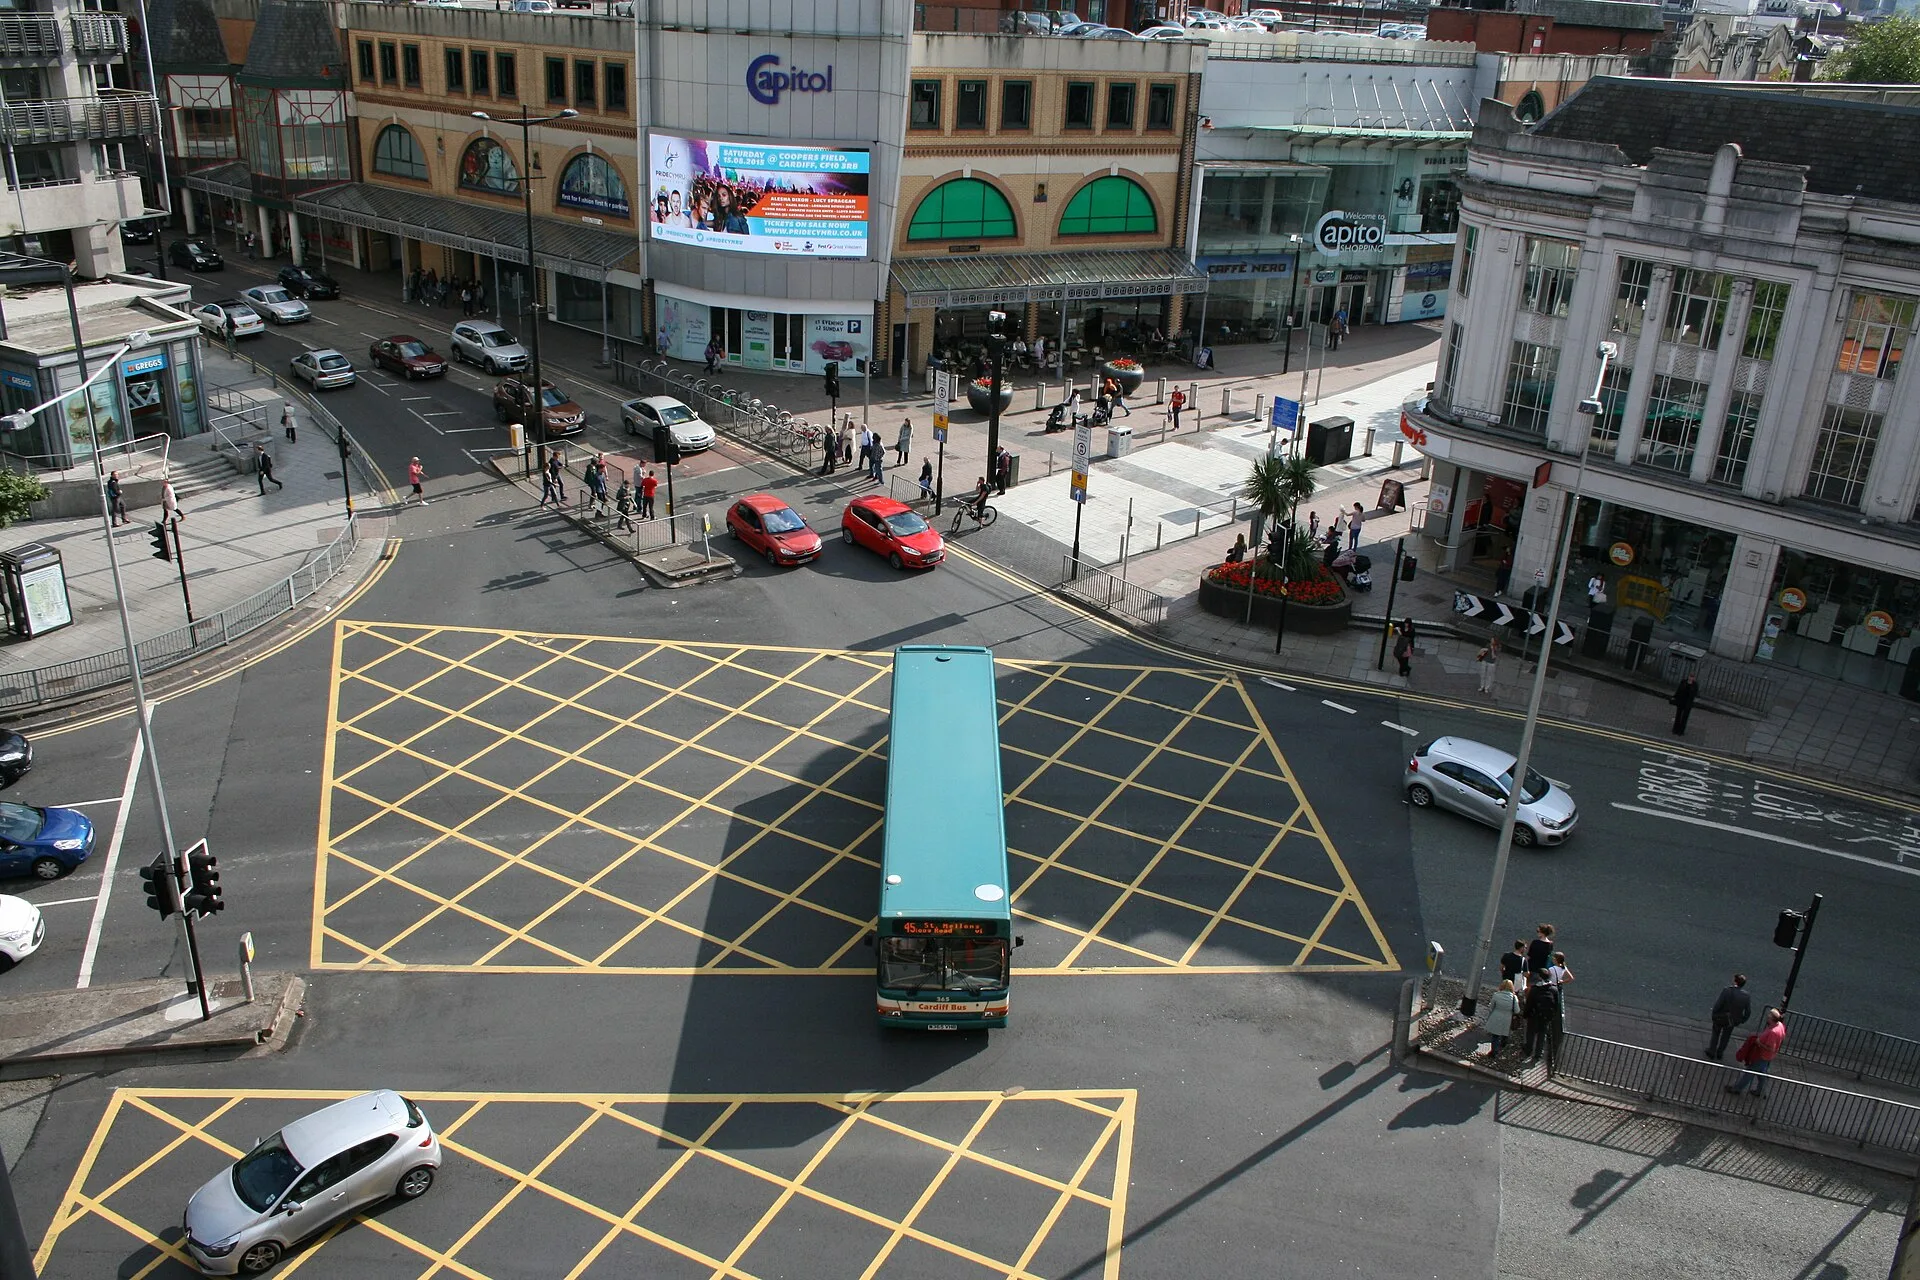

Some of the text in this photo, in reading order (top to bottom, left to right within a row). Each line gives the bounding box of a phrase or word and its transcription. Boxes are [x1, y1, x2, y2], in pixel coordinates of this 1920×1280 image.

[746, 54, 833, 105] Capitol
[723, 149, 765, 159] SATURDAY
[779, 152, 848, 163] COOPERS FIELD,
[724, 157, 765, 166] 15.08.2015
[767, 154, 778, 165] @
[779, 160, 818, 169] CARDIFF,
[819, 162, 839, 170] CF10
[612, 202, 629, 212] parking
[1345, 211, 1376, 220] Welcome
[764, 220, 794, 228] TICKETS
[765, 227, 863, 237] WWW.PRIDECYMRU.CO.UK
[1314, 210, 1387, 257] Capitol
[1340, 244, 1384, 253] SHOPPING
[1250, 263, 1287, 273] NERO
[822, 319, 844, 327] EVENING
[135, 358, 163, 371] GREGGS
[11, 376, 32, 388] GREGGS
[904, 922, 916, 933] 45
[918, 1003, 949, 1011] Cardiff
